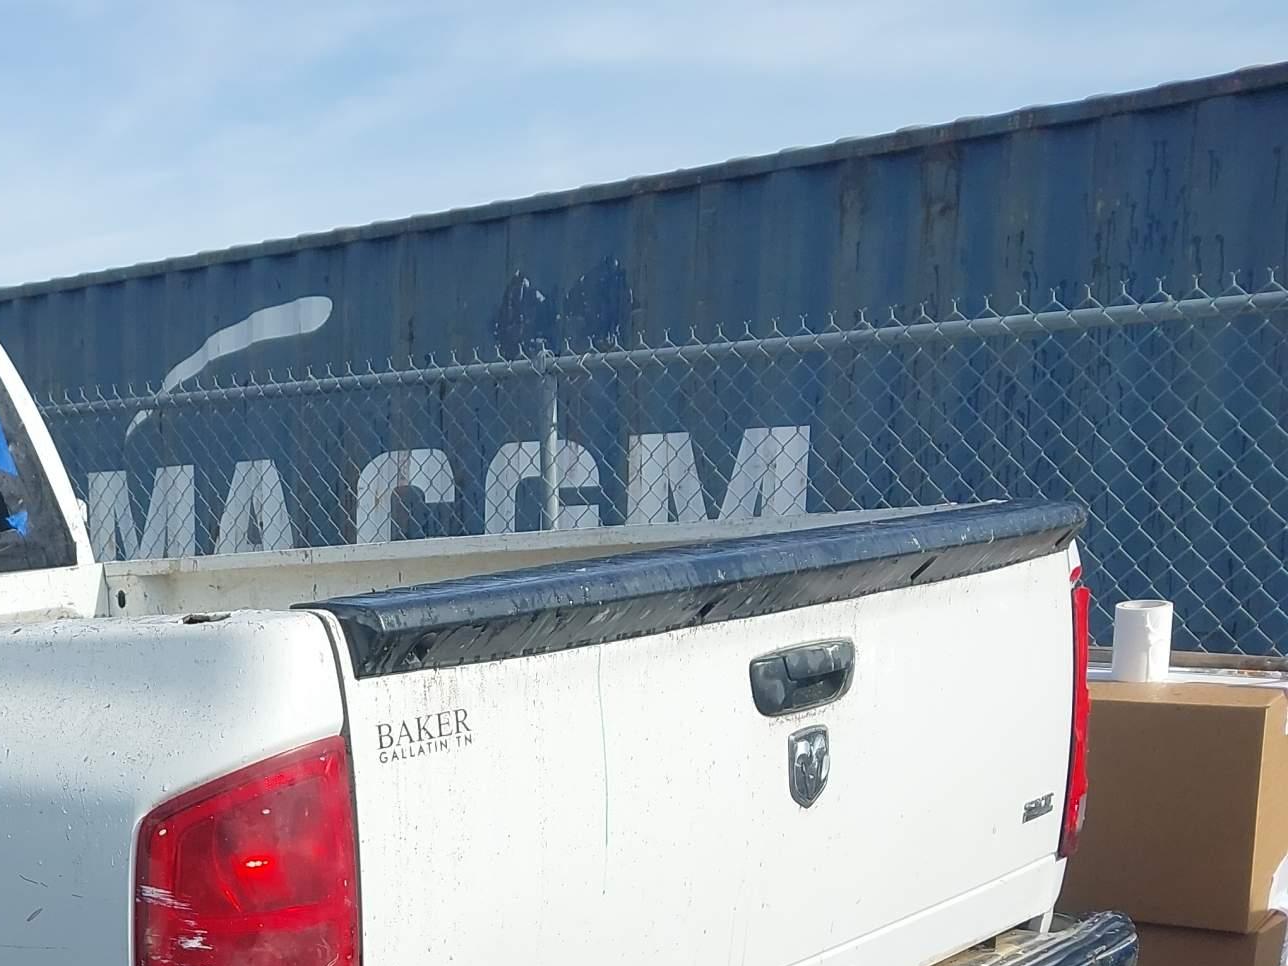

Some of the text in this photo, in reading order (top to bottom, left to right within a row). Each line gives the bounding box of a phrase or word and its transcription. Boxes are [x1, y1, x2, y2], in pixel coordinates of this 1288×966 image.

[376, 708, 472, 750] BAKER
[379, 734, 472, 764] GALLATIN TN
